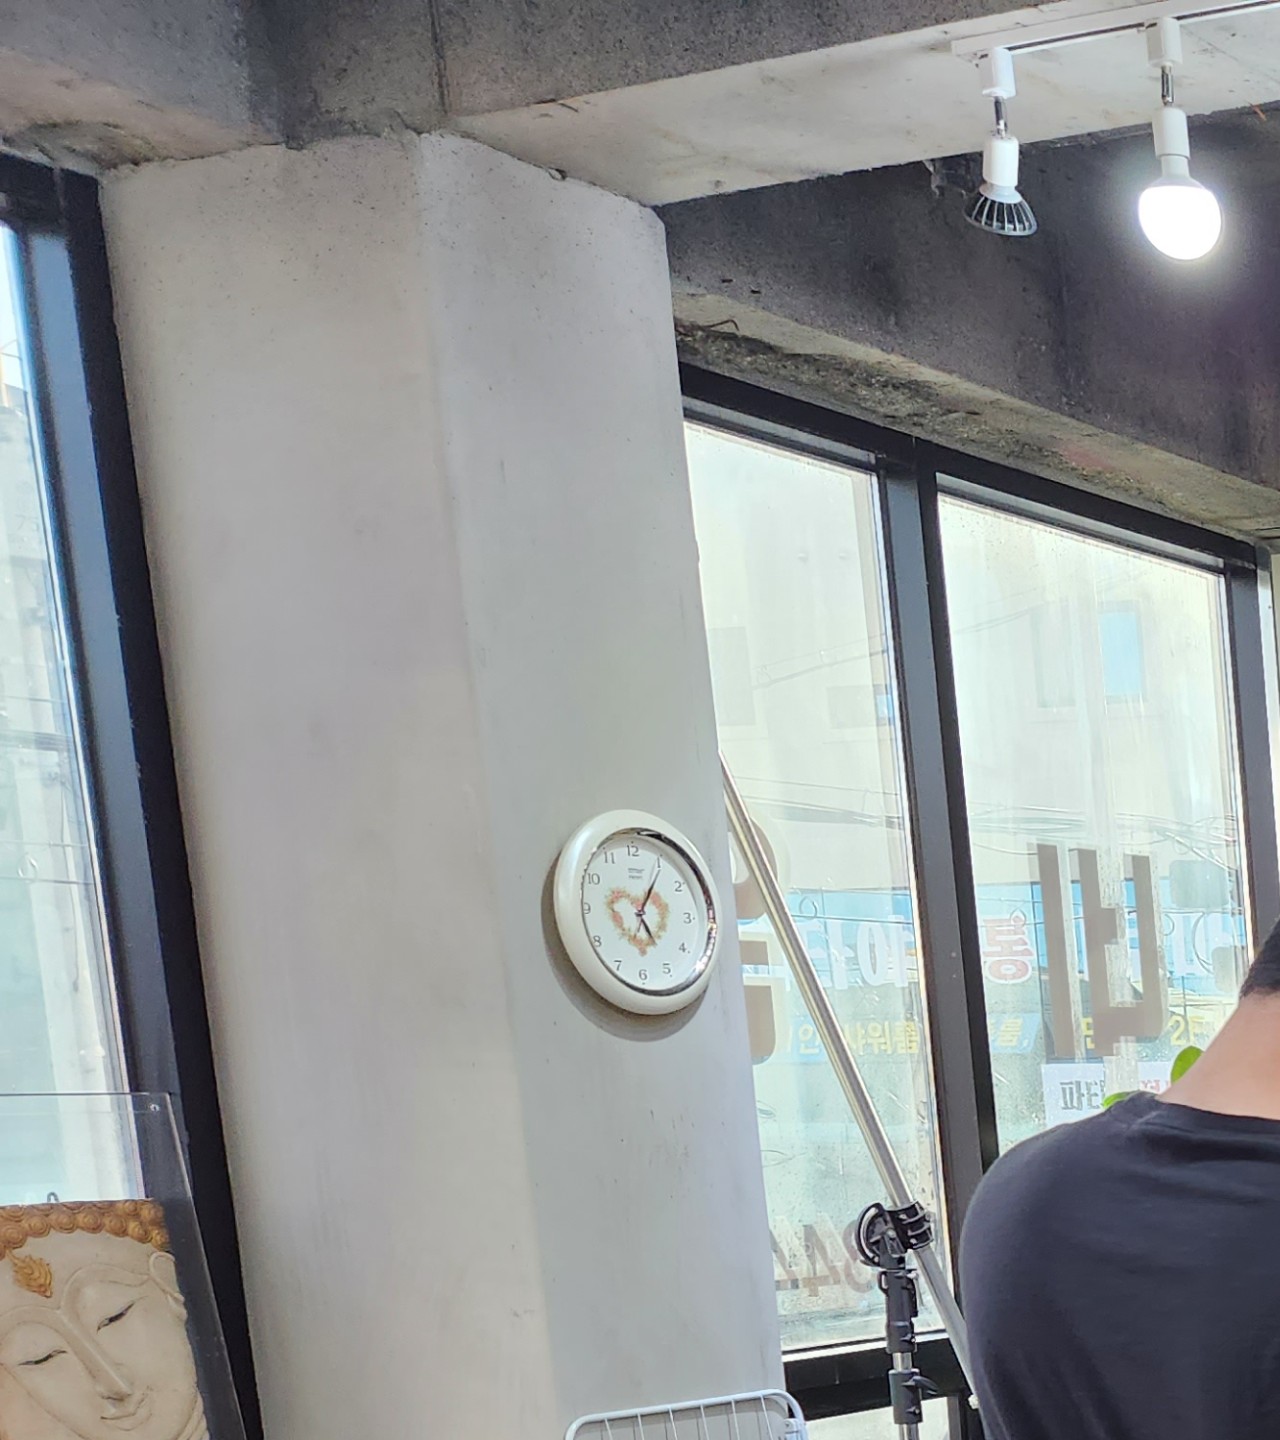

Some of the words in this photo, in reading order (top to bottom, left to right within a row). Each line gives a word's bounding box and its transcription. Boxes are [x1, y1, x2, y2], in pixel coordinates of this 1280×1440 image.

[626, 845, 640, 858] 12
[603, 852, 616, 865] 11
[587, 872, 601, 885] 10
